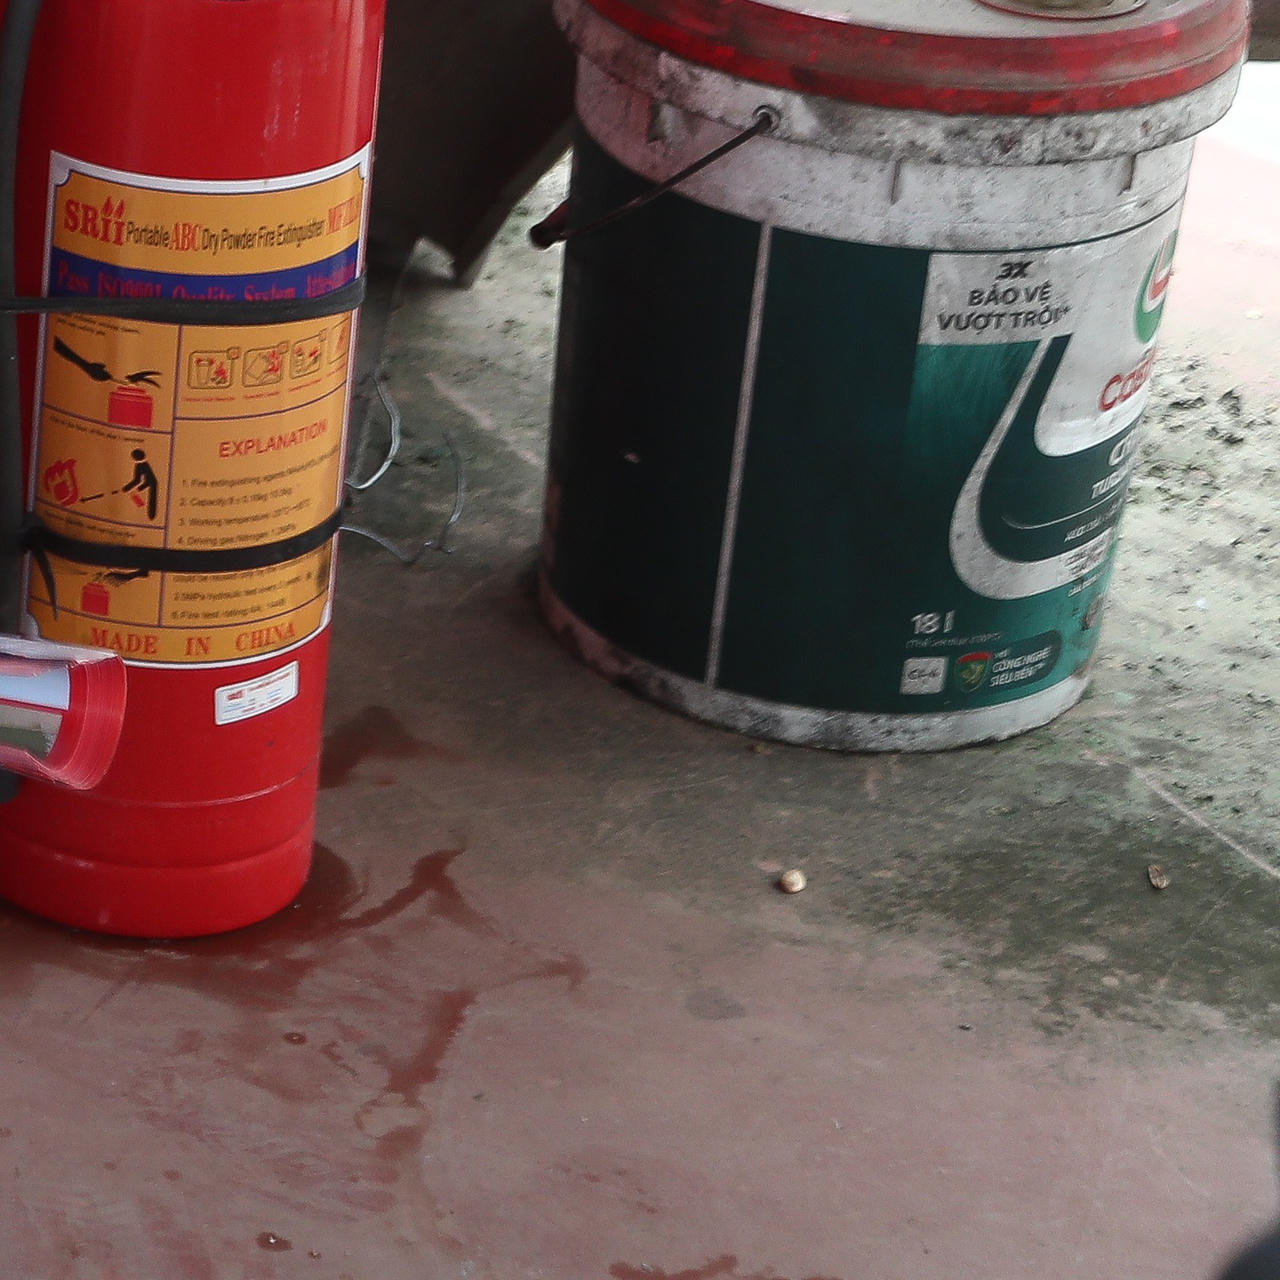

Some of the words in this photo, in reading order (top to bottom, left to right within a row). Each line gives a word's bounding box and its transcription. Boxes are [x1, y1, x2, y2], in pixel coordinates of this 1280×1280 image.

[126, 220, 170, 247] Portable
[169, 221, 202, 252] ABC
[201, 227, 219, 255] Dry
[220, 228, 257, 250] Powder
[256, 225, 276, 248] Fire
[276, 218, 327, 249] Extinguisher
[937, 310, 1007, 336] VƯỢT
[218, 419, 328, 458] EXPLANATION
[90, 627, 159, 655] MADE
[184, 635, 213, 657] IN
[235, 621, 296, 653] CHINA
[910, 611, 940, 635] 18
